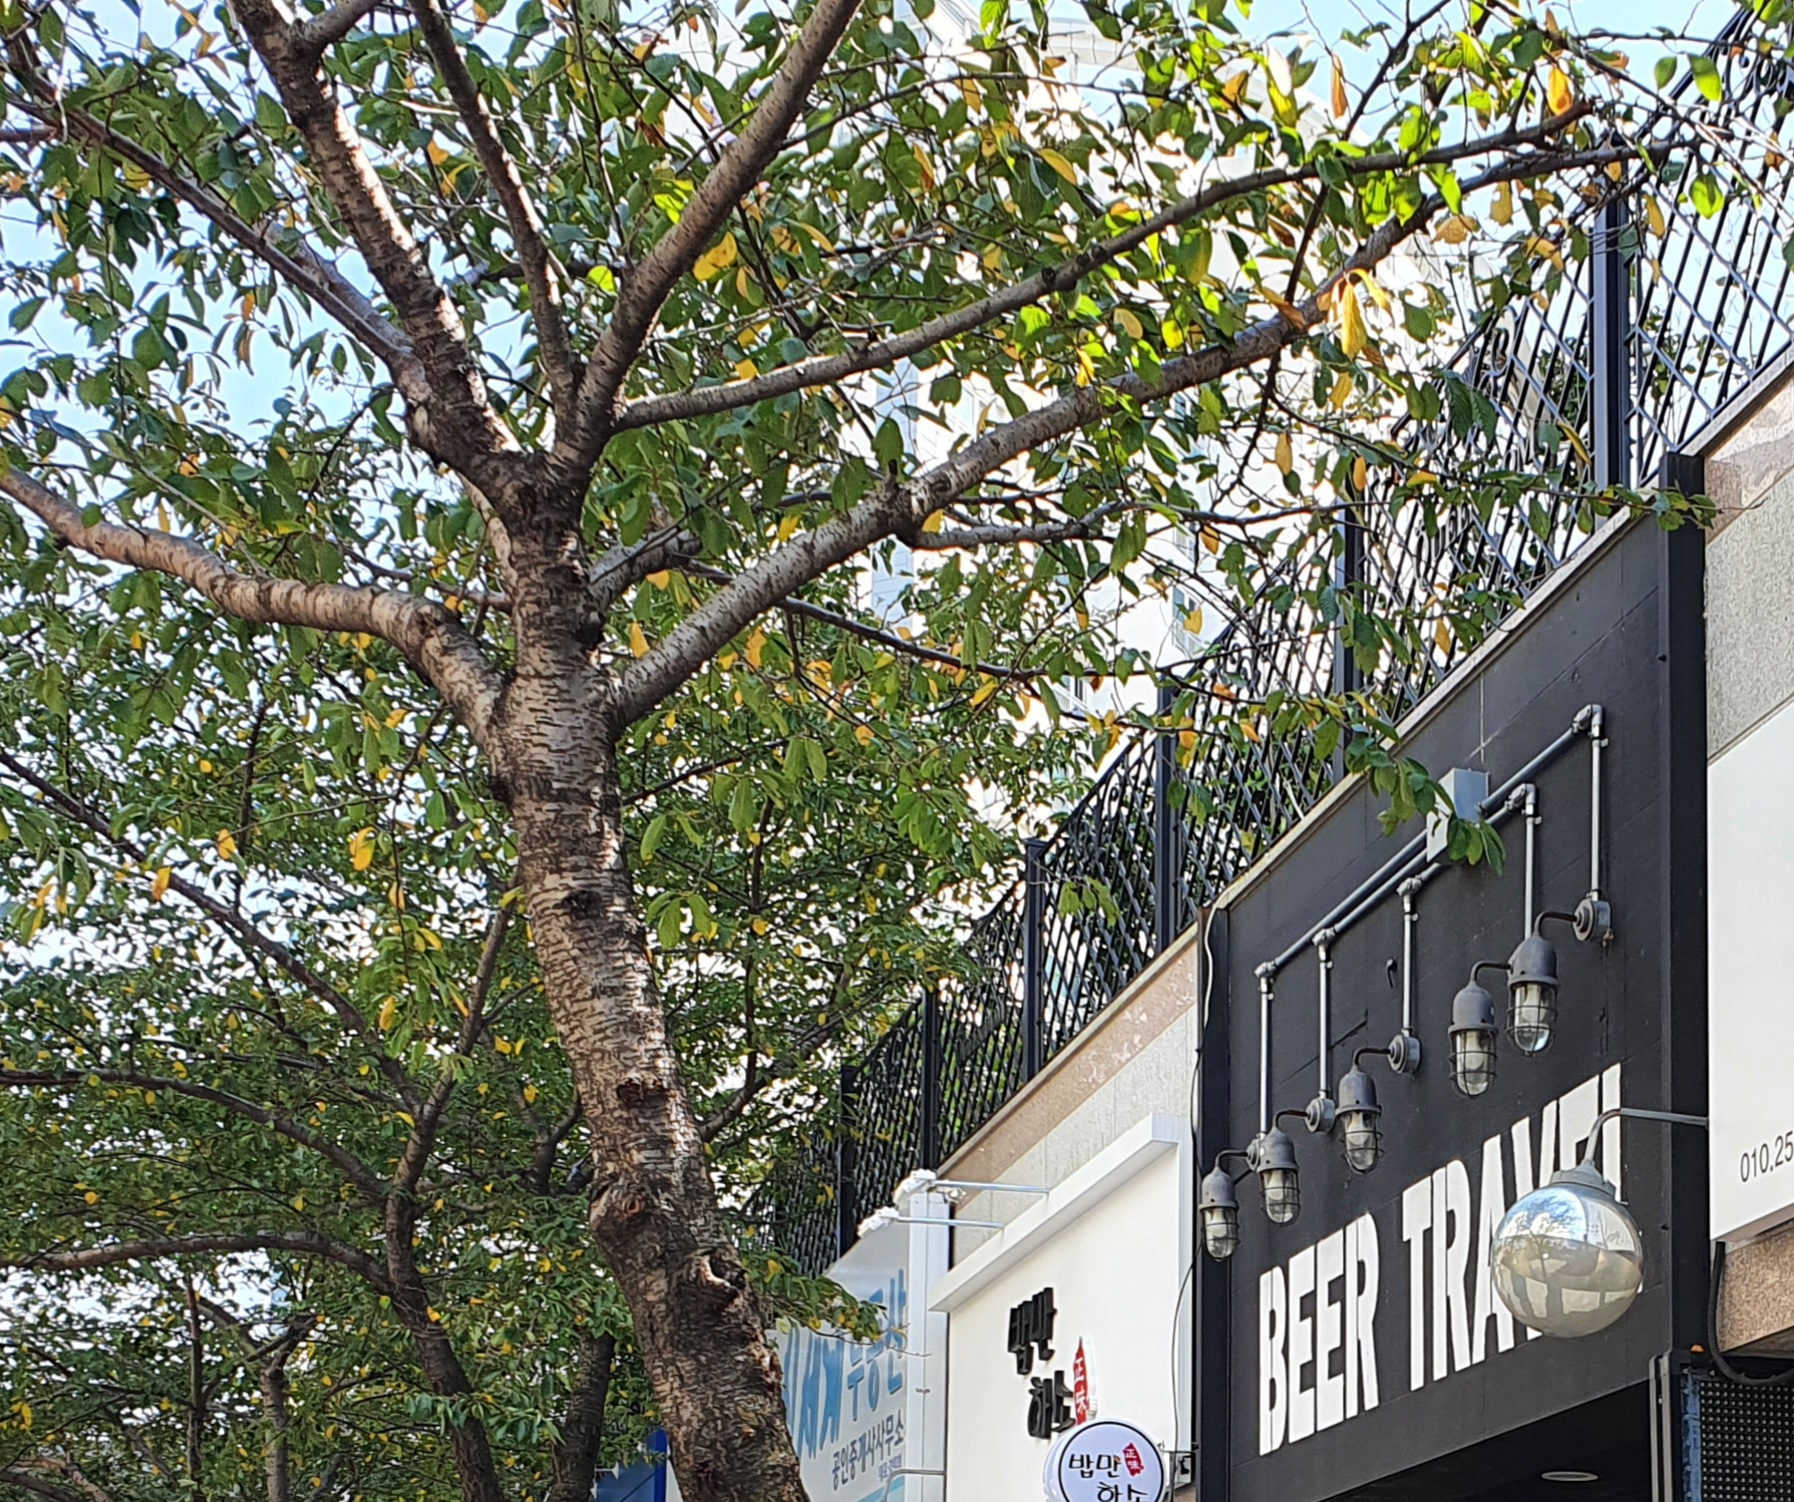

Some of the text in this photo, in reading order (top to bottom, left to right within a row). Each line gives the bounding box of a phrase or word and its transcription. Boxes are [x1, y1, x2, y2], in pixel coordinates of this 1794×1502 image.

[1259, 1212, 1379, 1456] BEER
[832, 1408, 904, 1491] 공인중개사사무소
[1068, 1453, 1122, 1479] 밥만
